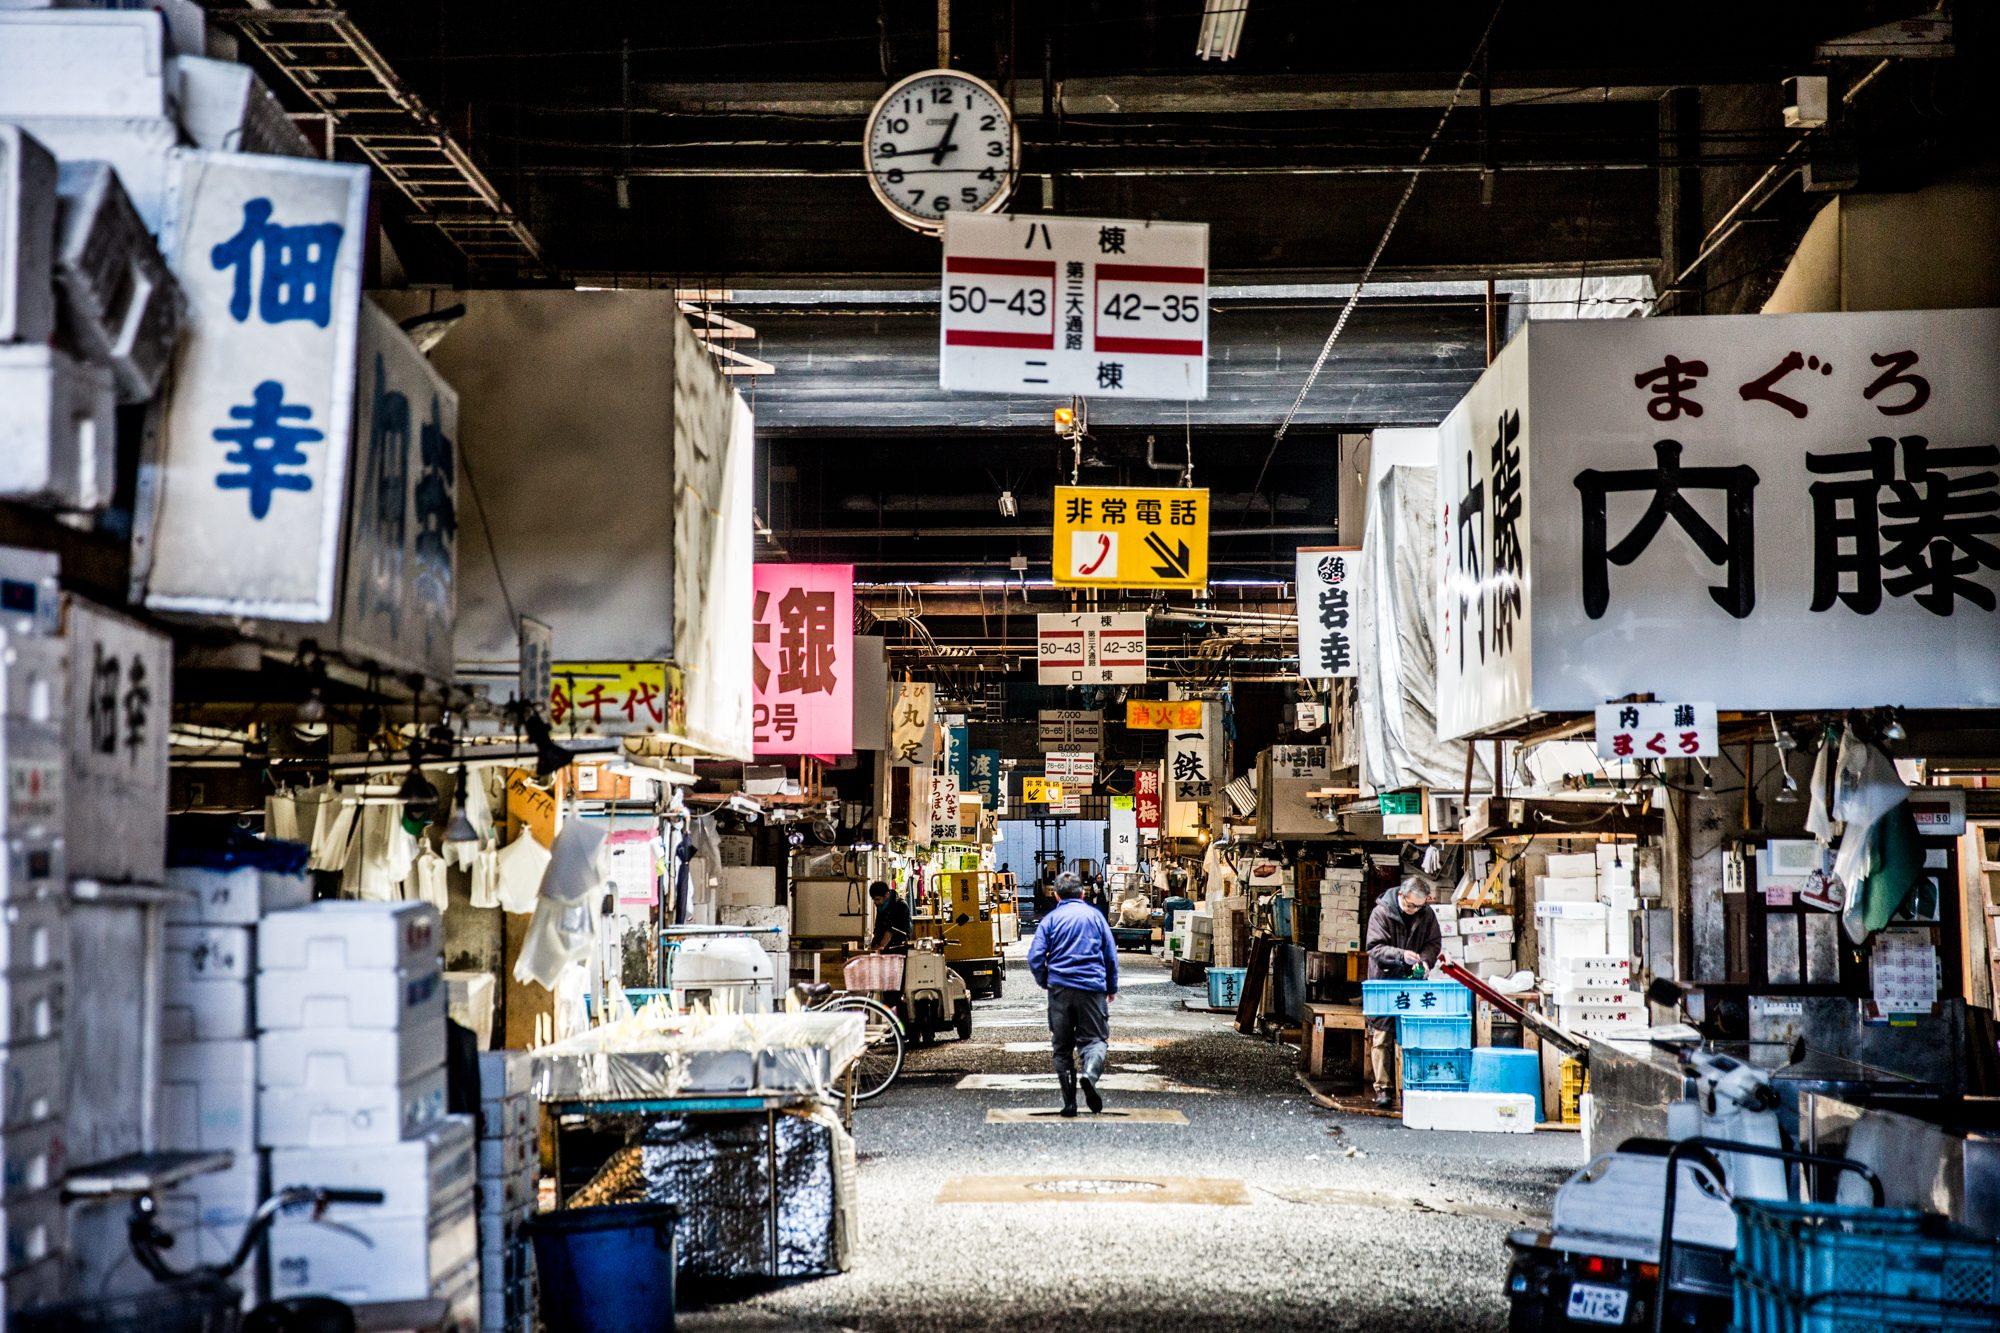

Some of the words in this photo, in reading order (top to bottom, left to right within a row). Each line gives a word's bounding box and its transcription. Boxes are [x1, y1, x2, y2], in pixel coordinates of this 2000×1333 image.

[931, 88, 952, 104] 12
[965, 95, 972, 110] 1
[904, 98, 923, 113] 11
[887, 118, 908, 134] 10
[980, 115, 996, 131] 2
[880, 142, 897, 158] 9
[987, 141, 1003, 157] 3
[887, 168, 904, 184] 8
[978, 167, 996, 182] 4
[908, 190, 925, 205] 7
[961, 187, 978, 203] 5
[933, 196, 950, 212] 6
[949, 285, 1046, 317] 50-43
[1065, 261, 1085, 351] 第三大通路
[1104, 293, 1199, 323] 42-35
[1634, 350, 1931, 421] まぐろ
[1066, 497, 1197, 526] 非常電話
[1573, 436, 2000, 619] 内藤
[1318, 587, 1351, 674] 岩幸
[1040, 642, 1081, 654] 50-43
[1104, 641, 1144, 653] 42-35
[900, 686, 925, 698] えび
[1132, 705, 1198, 726] 消火栓
[1620, 704, 1695, 729] 内藤
[898, 704, 925, 765] 丸定
[945, 778, 958, 820] うなぎ
[1139, 772, 1159, 824] 熊梅
[1119, 835, 1129, 844] 34
